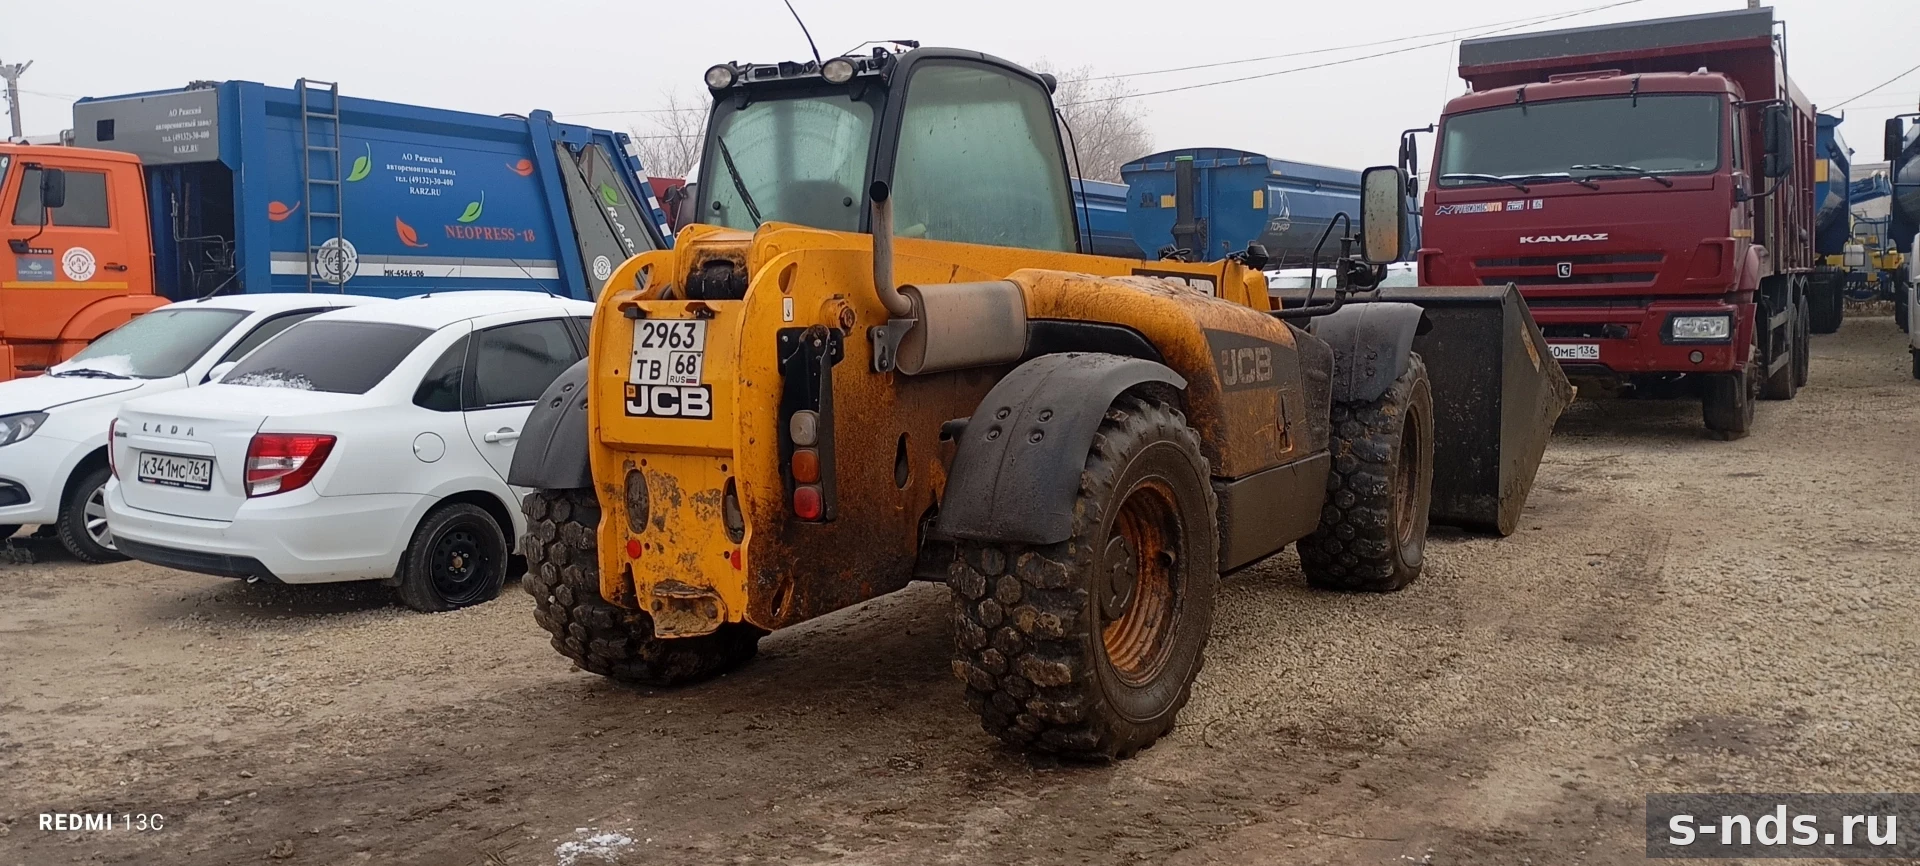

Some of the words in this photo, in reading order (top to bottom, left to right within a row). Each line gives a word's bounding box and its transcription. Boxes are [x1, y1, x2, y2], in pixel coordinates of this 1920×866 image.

[401, 152, 413, 161] АО
[414, 153, 443, 164] Ряжский
[386, 164, 438, 174] авторемонтный
[439, 168, 456, 176] завод
[409, 186, 441, 196] RARZ.RU
[607, 206, 635, 256] R.A.R.
[1520, 233, 1609, 244] KAMAZ
[641, 322, 697, 349] 2963
[636, 359, 662, 380] ТВ
[675, 354, 697, 375] 68
[1222, 346, 1273, 386] JCB
[669, 375, 686, 384] RUS
[626, 385, 711, 417] JCB
[142, 422, 194, 437] LADA
